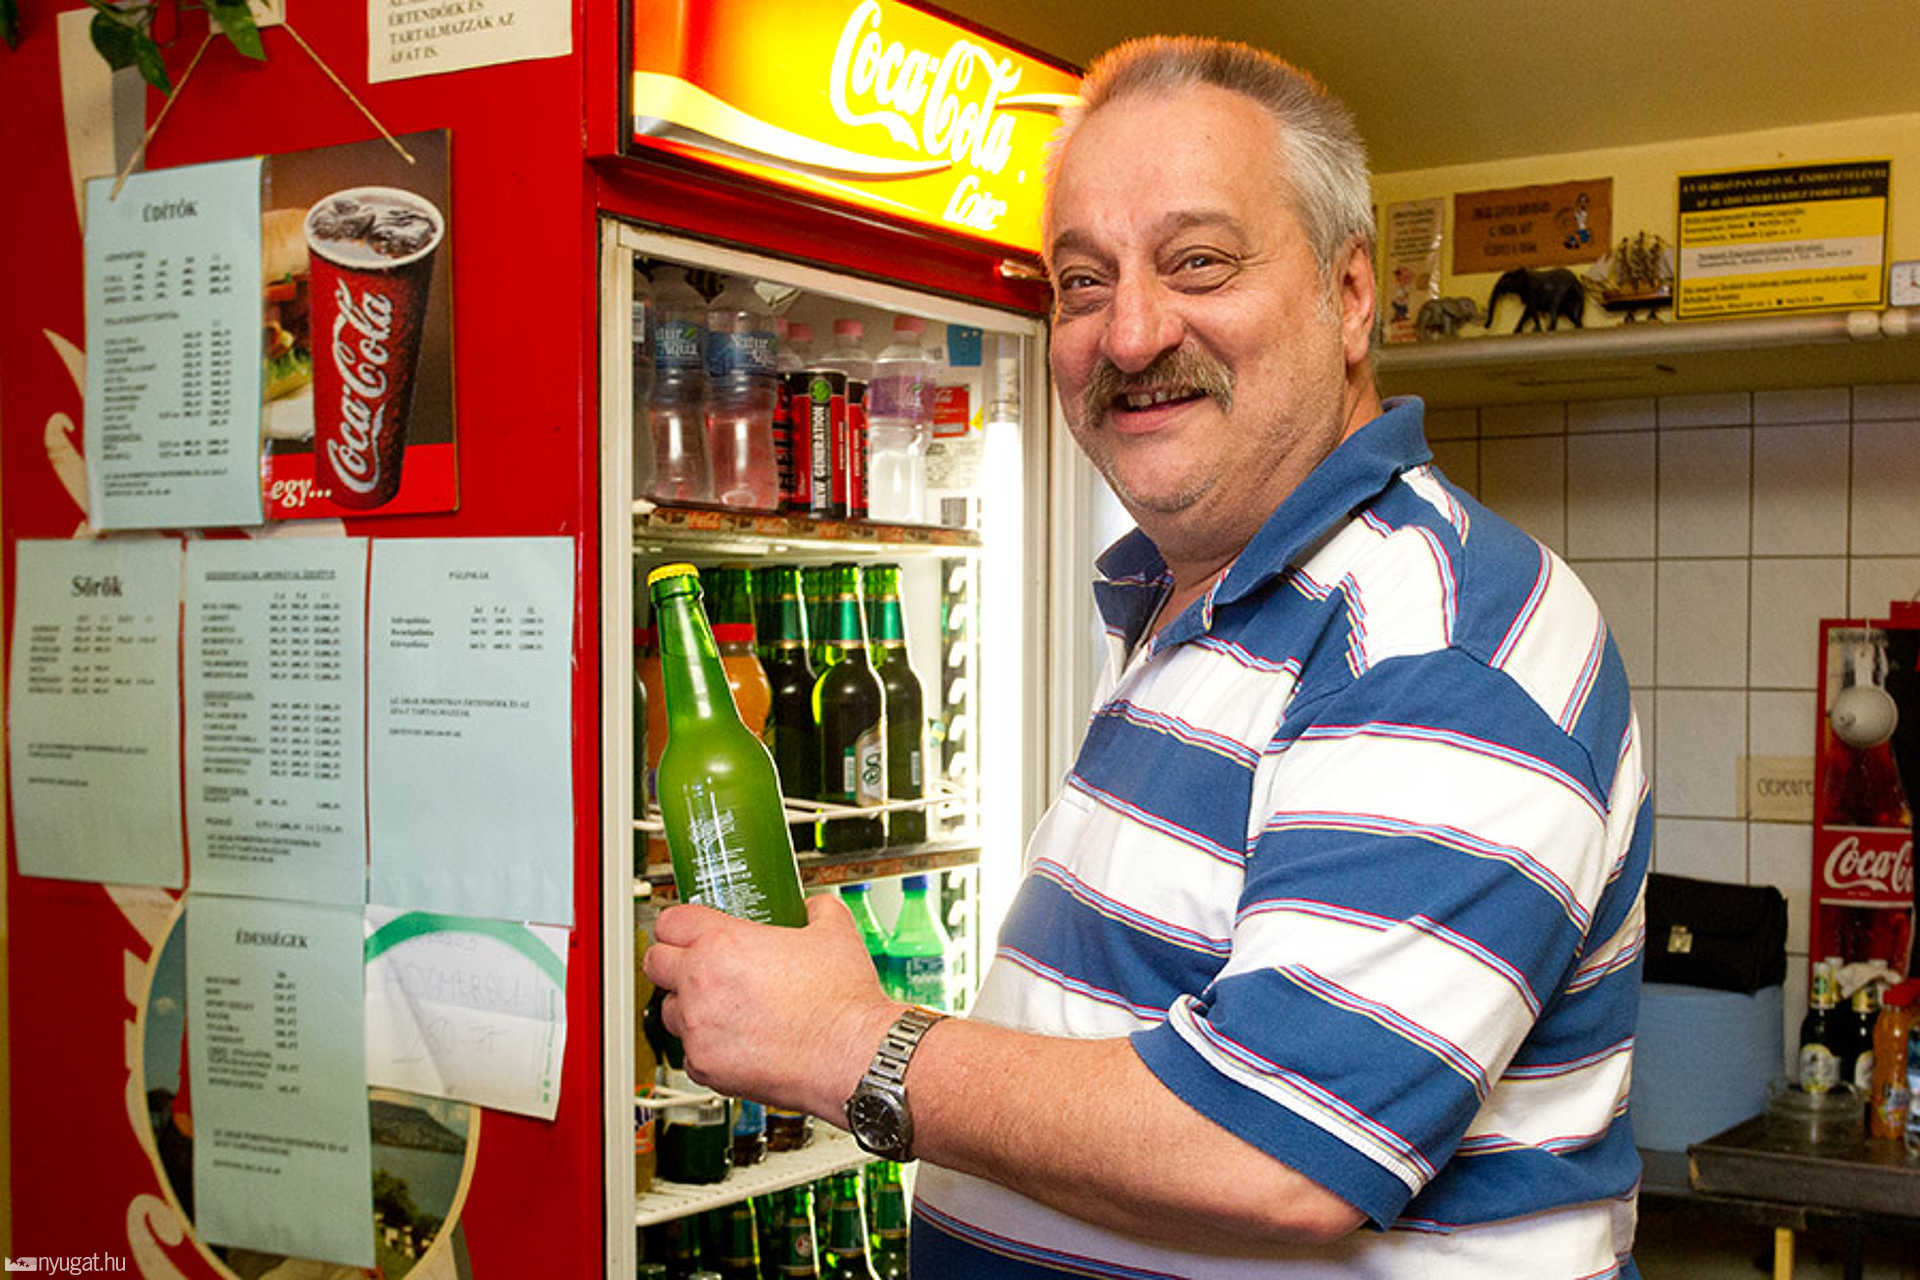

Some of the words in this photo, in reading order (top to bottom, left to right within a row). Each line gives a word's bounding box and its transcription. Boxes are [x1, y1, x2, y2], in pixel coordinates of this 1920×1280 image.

[829, 0, 1023, 175] Coca-Cola
[327, 277, 393, 493] Coca-Cola
[271, 478, 332, 508] egy...
[70, 575, 124, 597] Sörök
